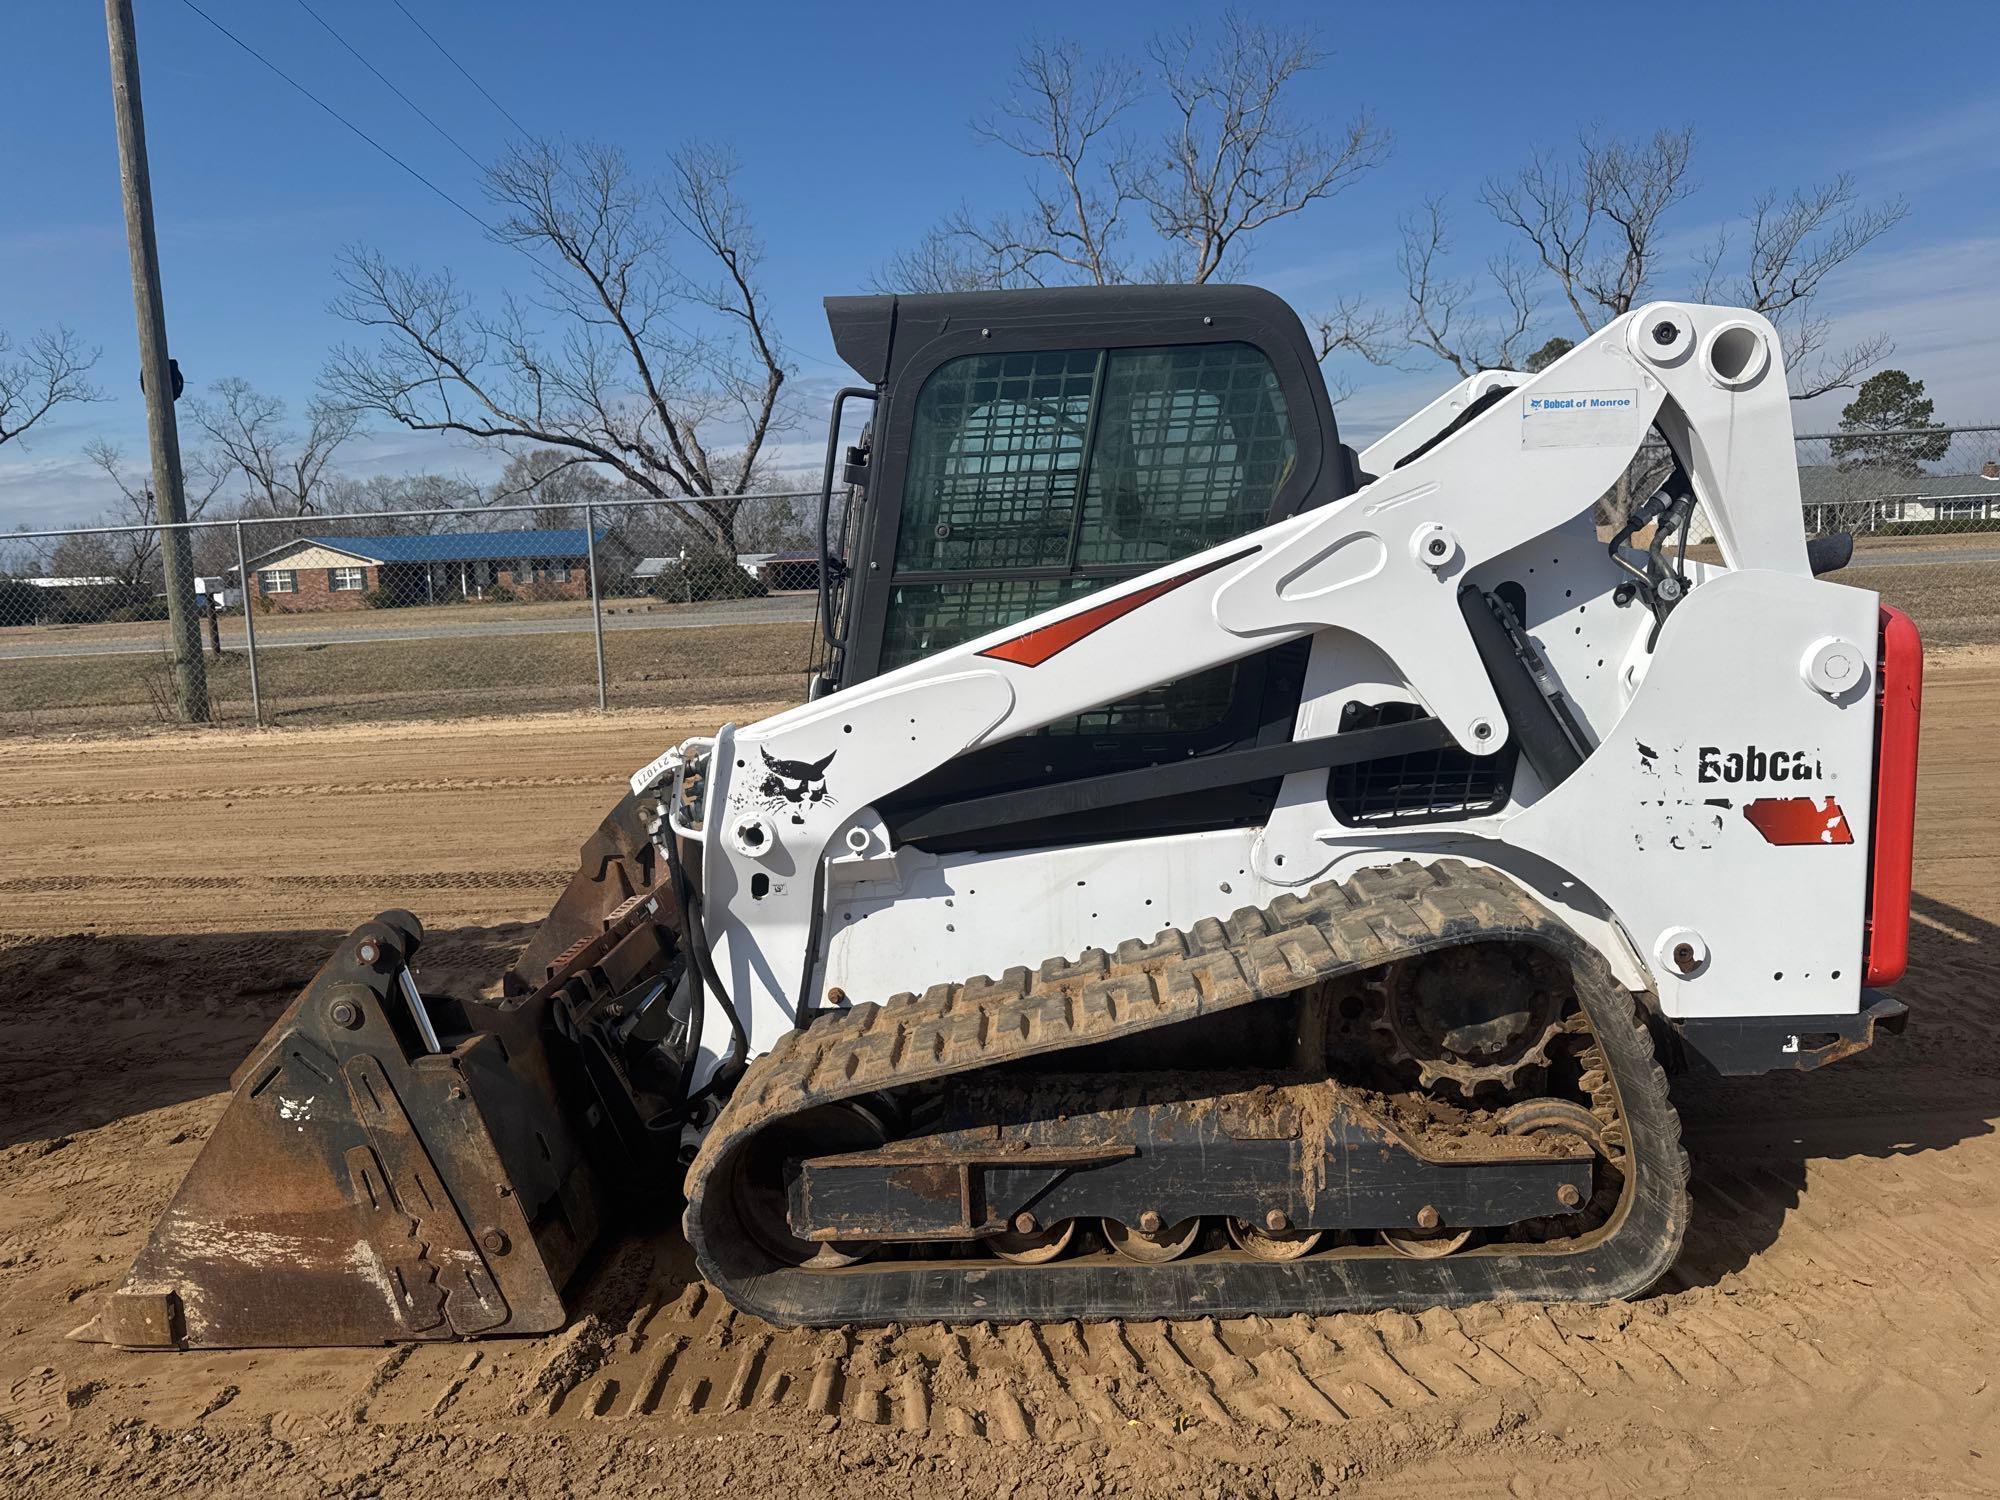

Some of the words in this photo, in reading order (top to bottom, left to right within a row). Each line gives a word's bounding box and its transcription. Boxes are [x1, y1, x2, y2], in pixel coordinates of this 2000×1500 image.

[1543, 399, 1574, 409] Bobcat
[1575, 399, 1587, 408] of
[1590, 398, 1630, 407] Monroe
